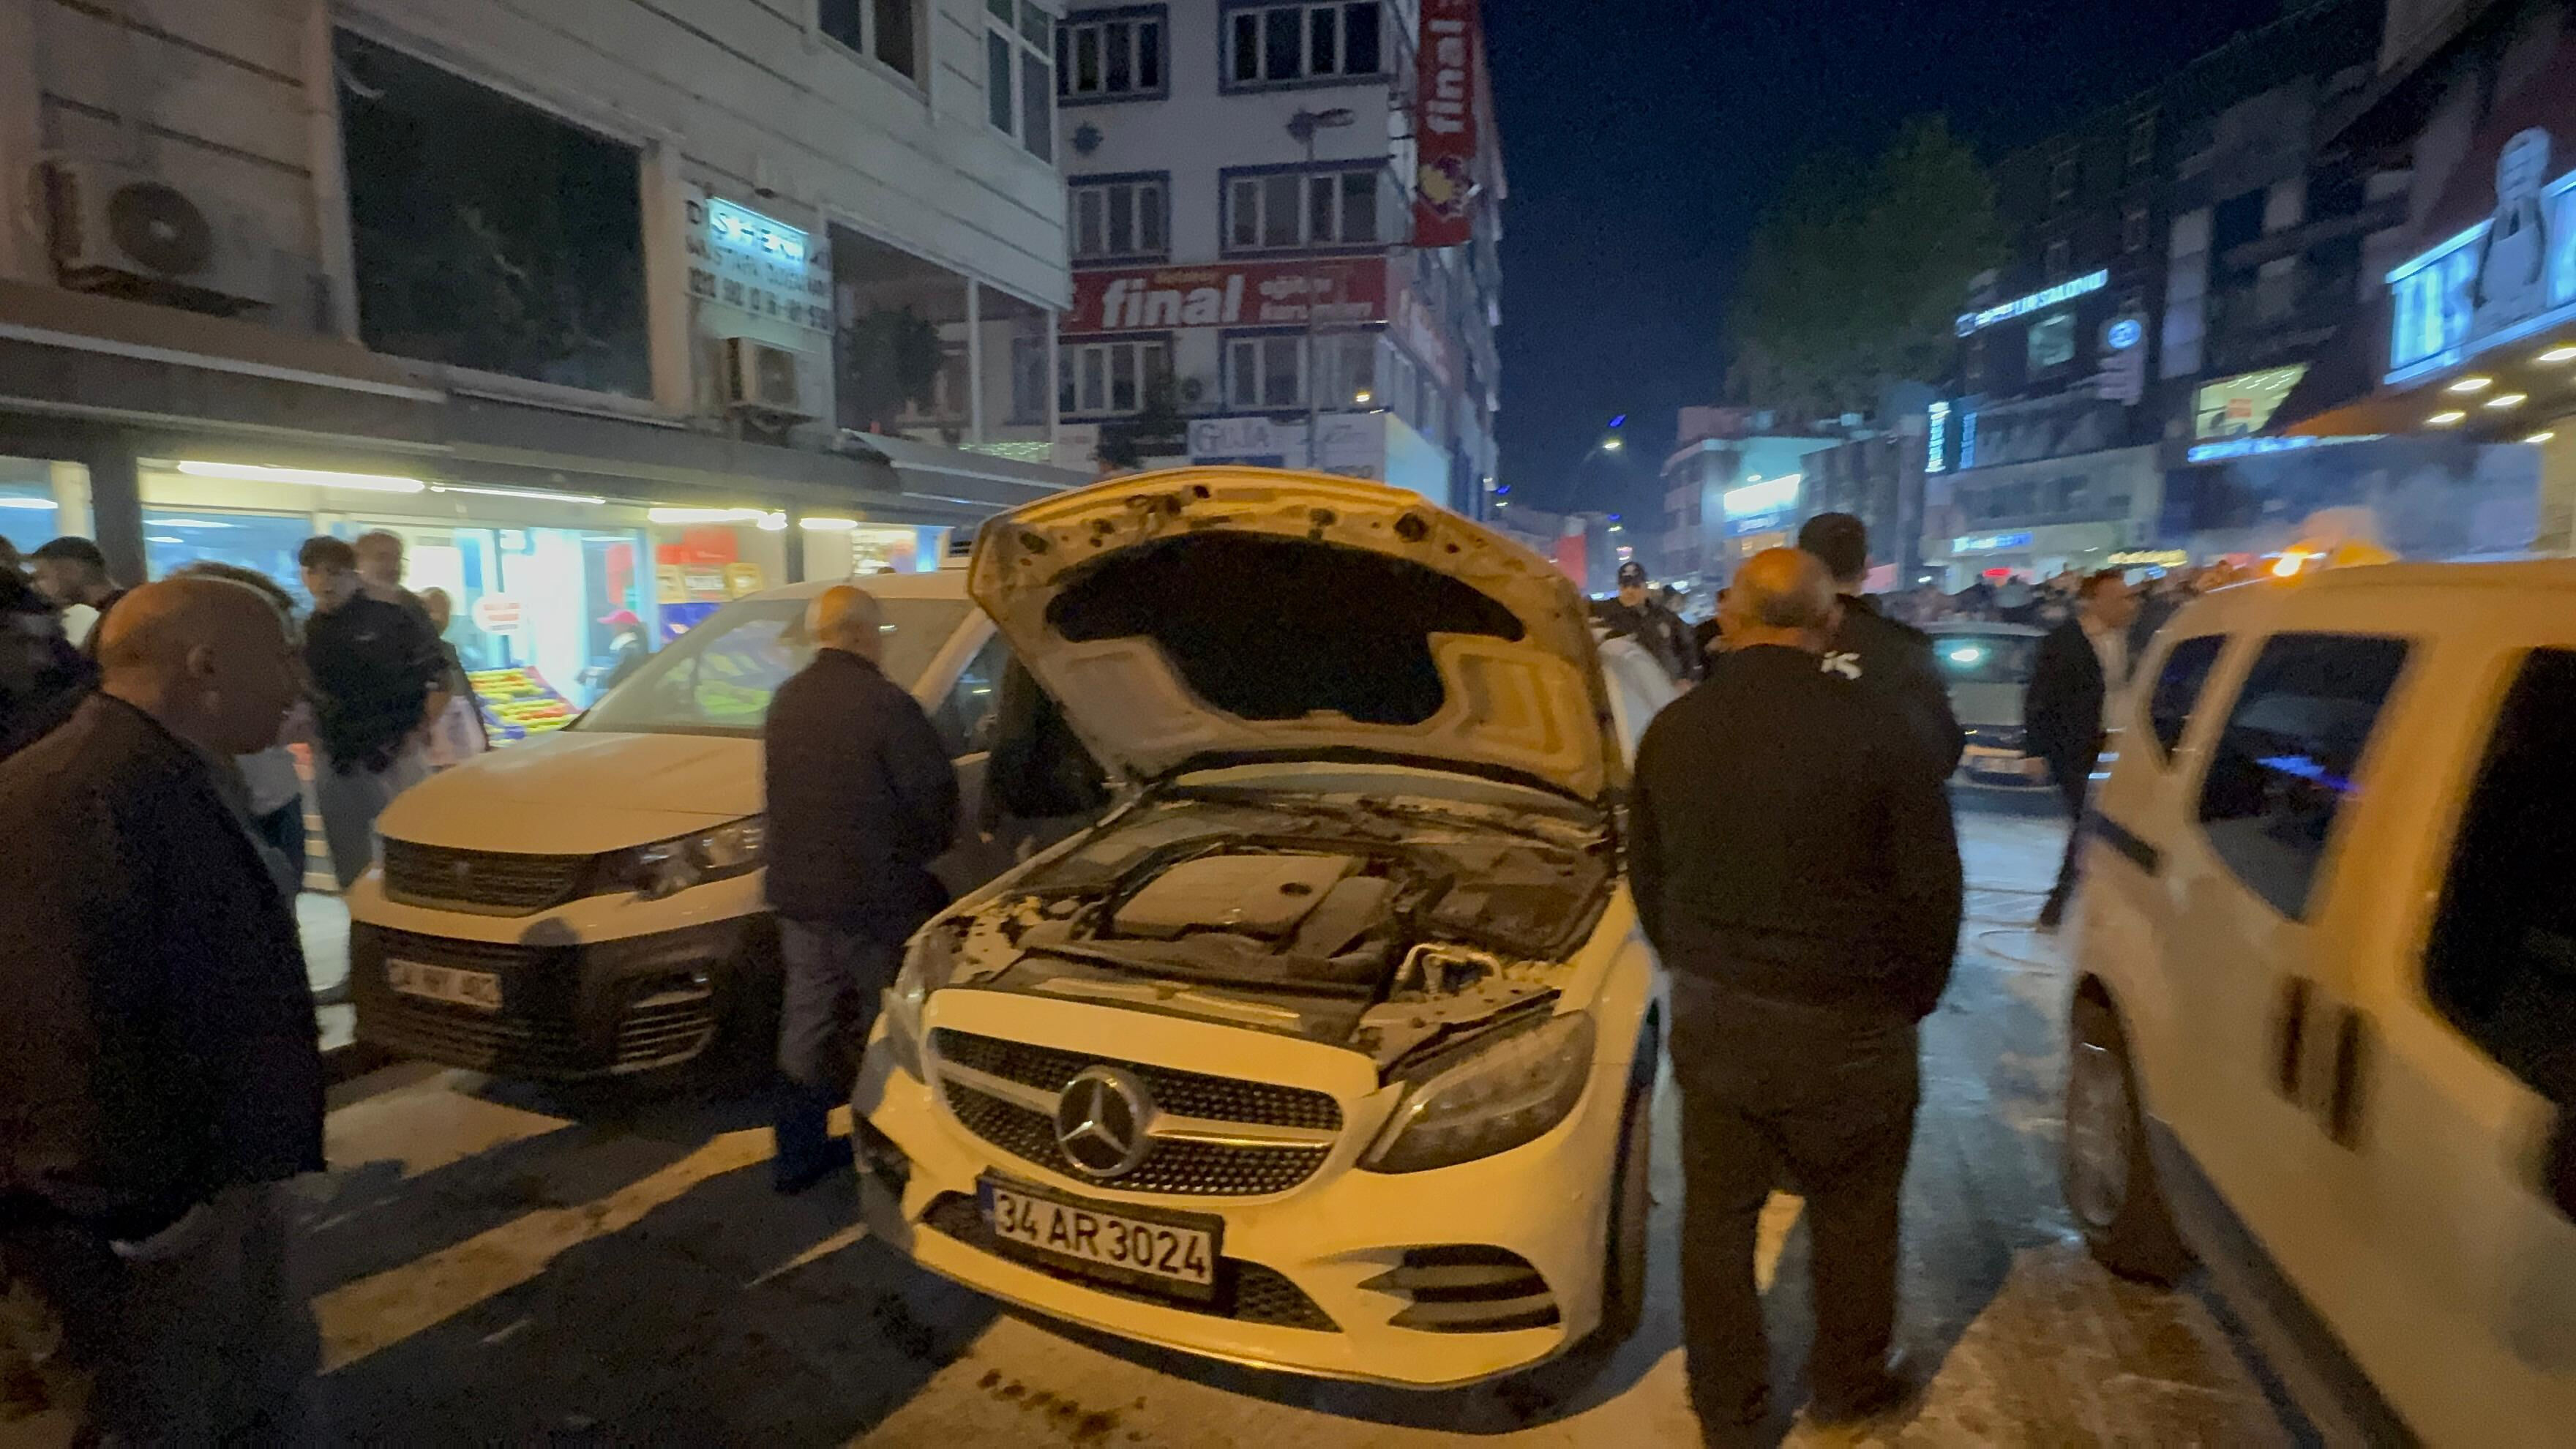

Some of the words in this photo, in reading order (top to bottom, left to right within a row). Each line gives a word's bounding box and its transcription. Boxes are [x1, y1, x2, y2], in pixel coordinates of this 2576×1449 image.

[1425, 19, 1464, 135] final
[1101, 274, 1243, 329] final
[997, 1194, 1038, 1241] 34
[1047, 1208, 1098, 1257] AR
[1107, 1220, 1205, 1278] 3024
